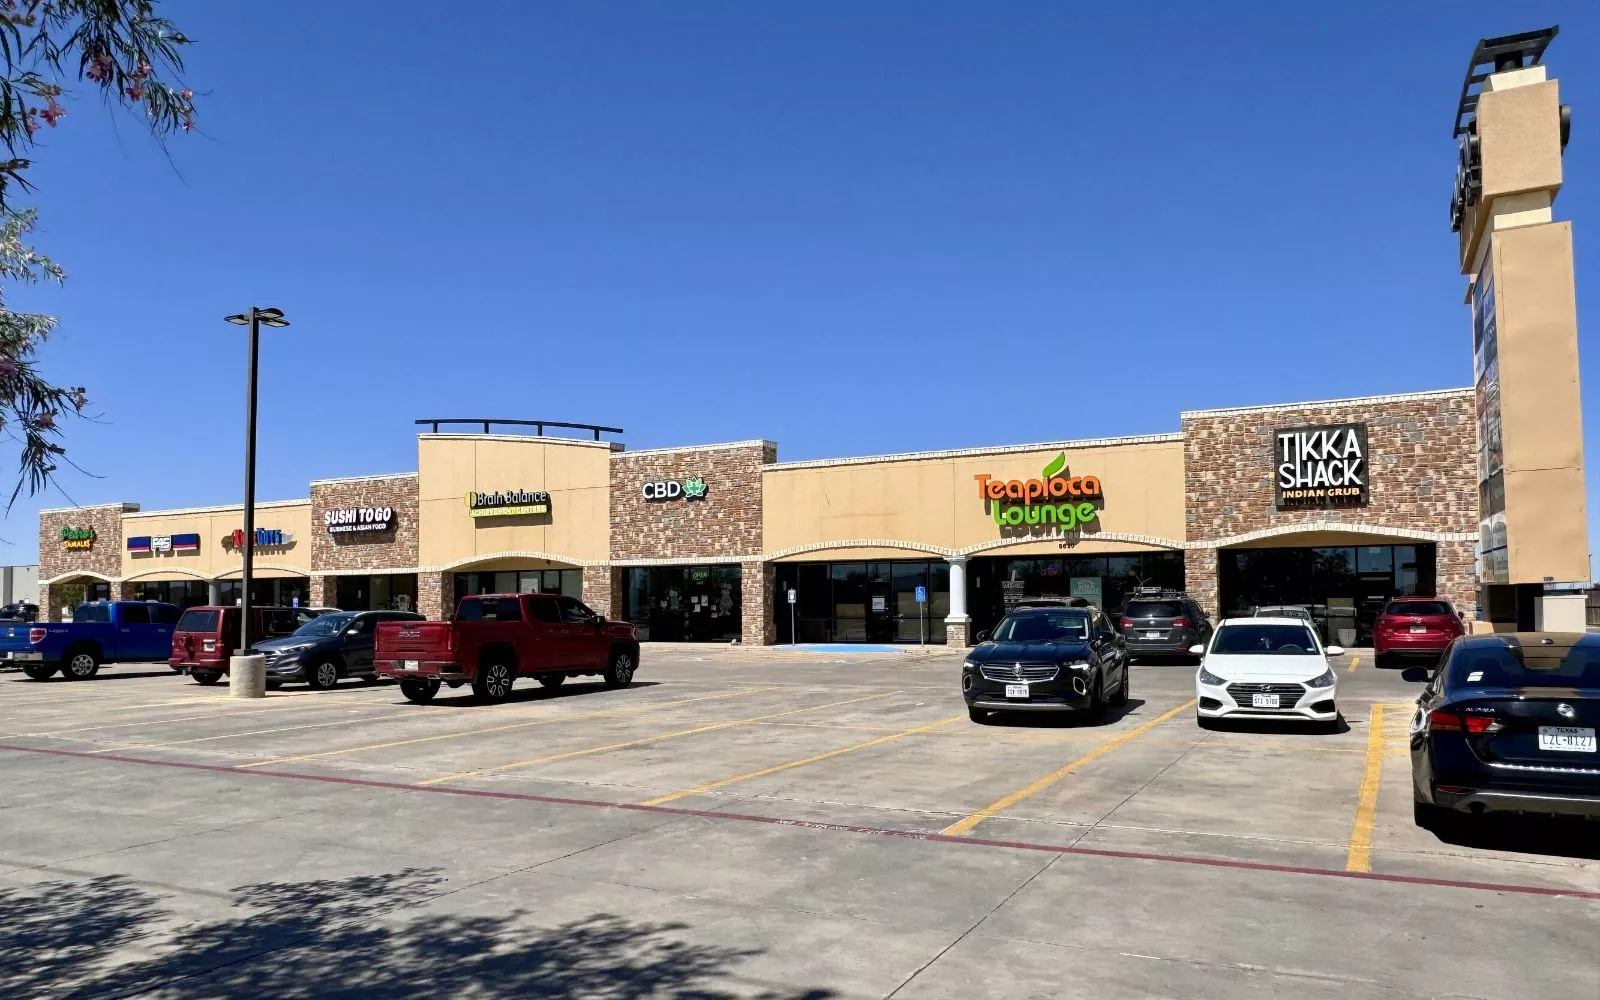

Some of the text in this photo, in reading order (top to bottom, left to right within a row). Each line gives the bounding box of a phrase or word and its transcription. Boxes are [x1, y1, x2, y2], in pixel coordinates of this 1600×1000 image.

[1278, 428, 1362, 462] TIKKA
[1279, 458, 1364, 488] SHACK
[477, 490, 547, 506] Brain Balance
[642, 481, 681, 499] CBD
[974, 473, 1100, 505] Teapioca
[1282, 487, 1360, 498] INDIAN GRUB
[324, 508, 357, 525] SUSHI
[992, 499, 1096, 531] Lounge
